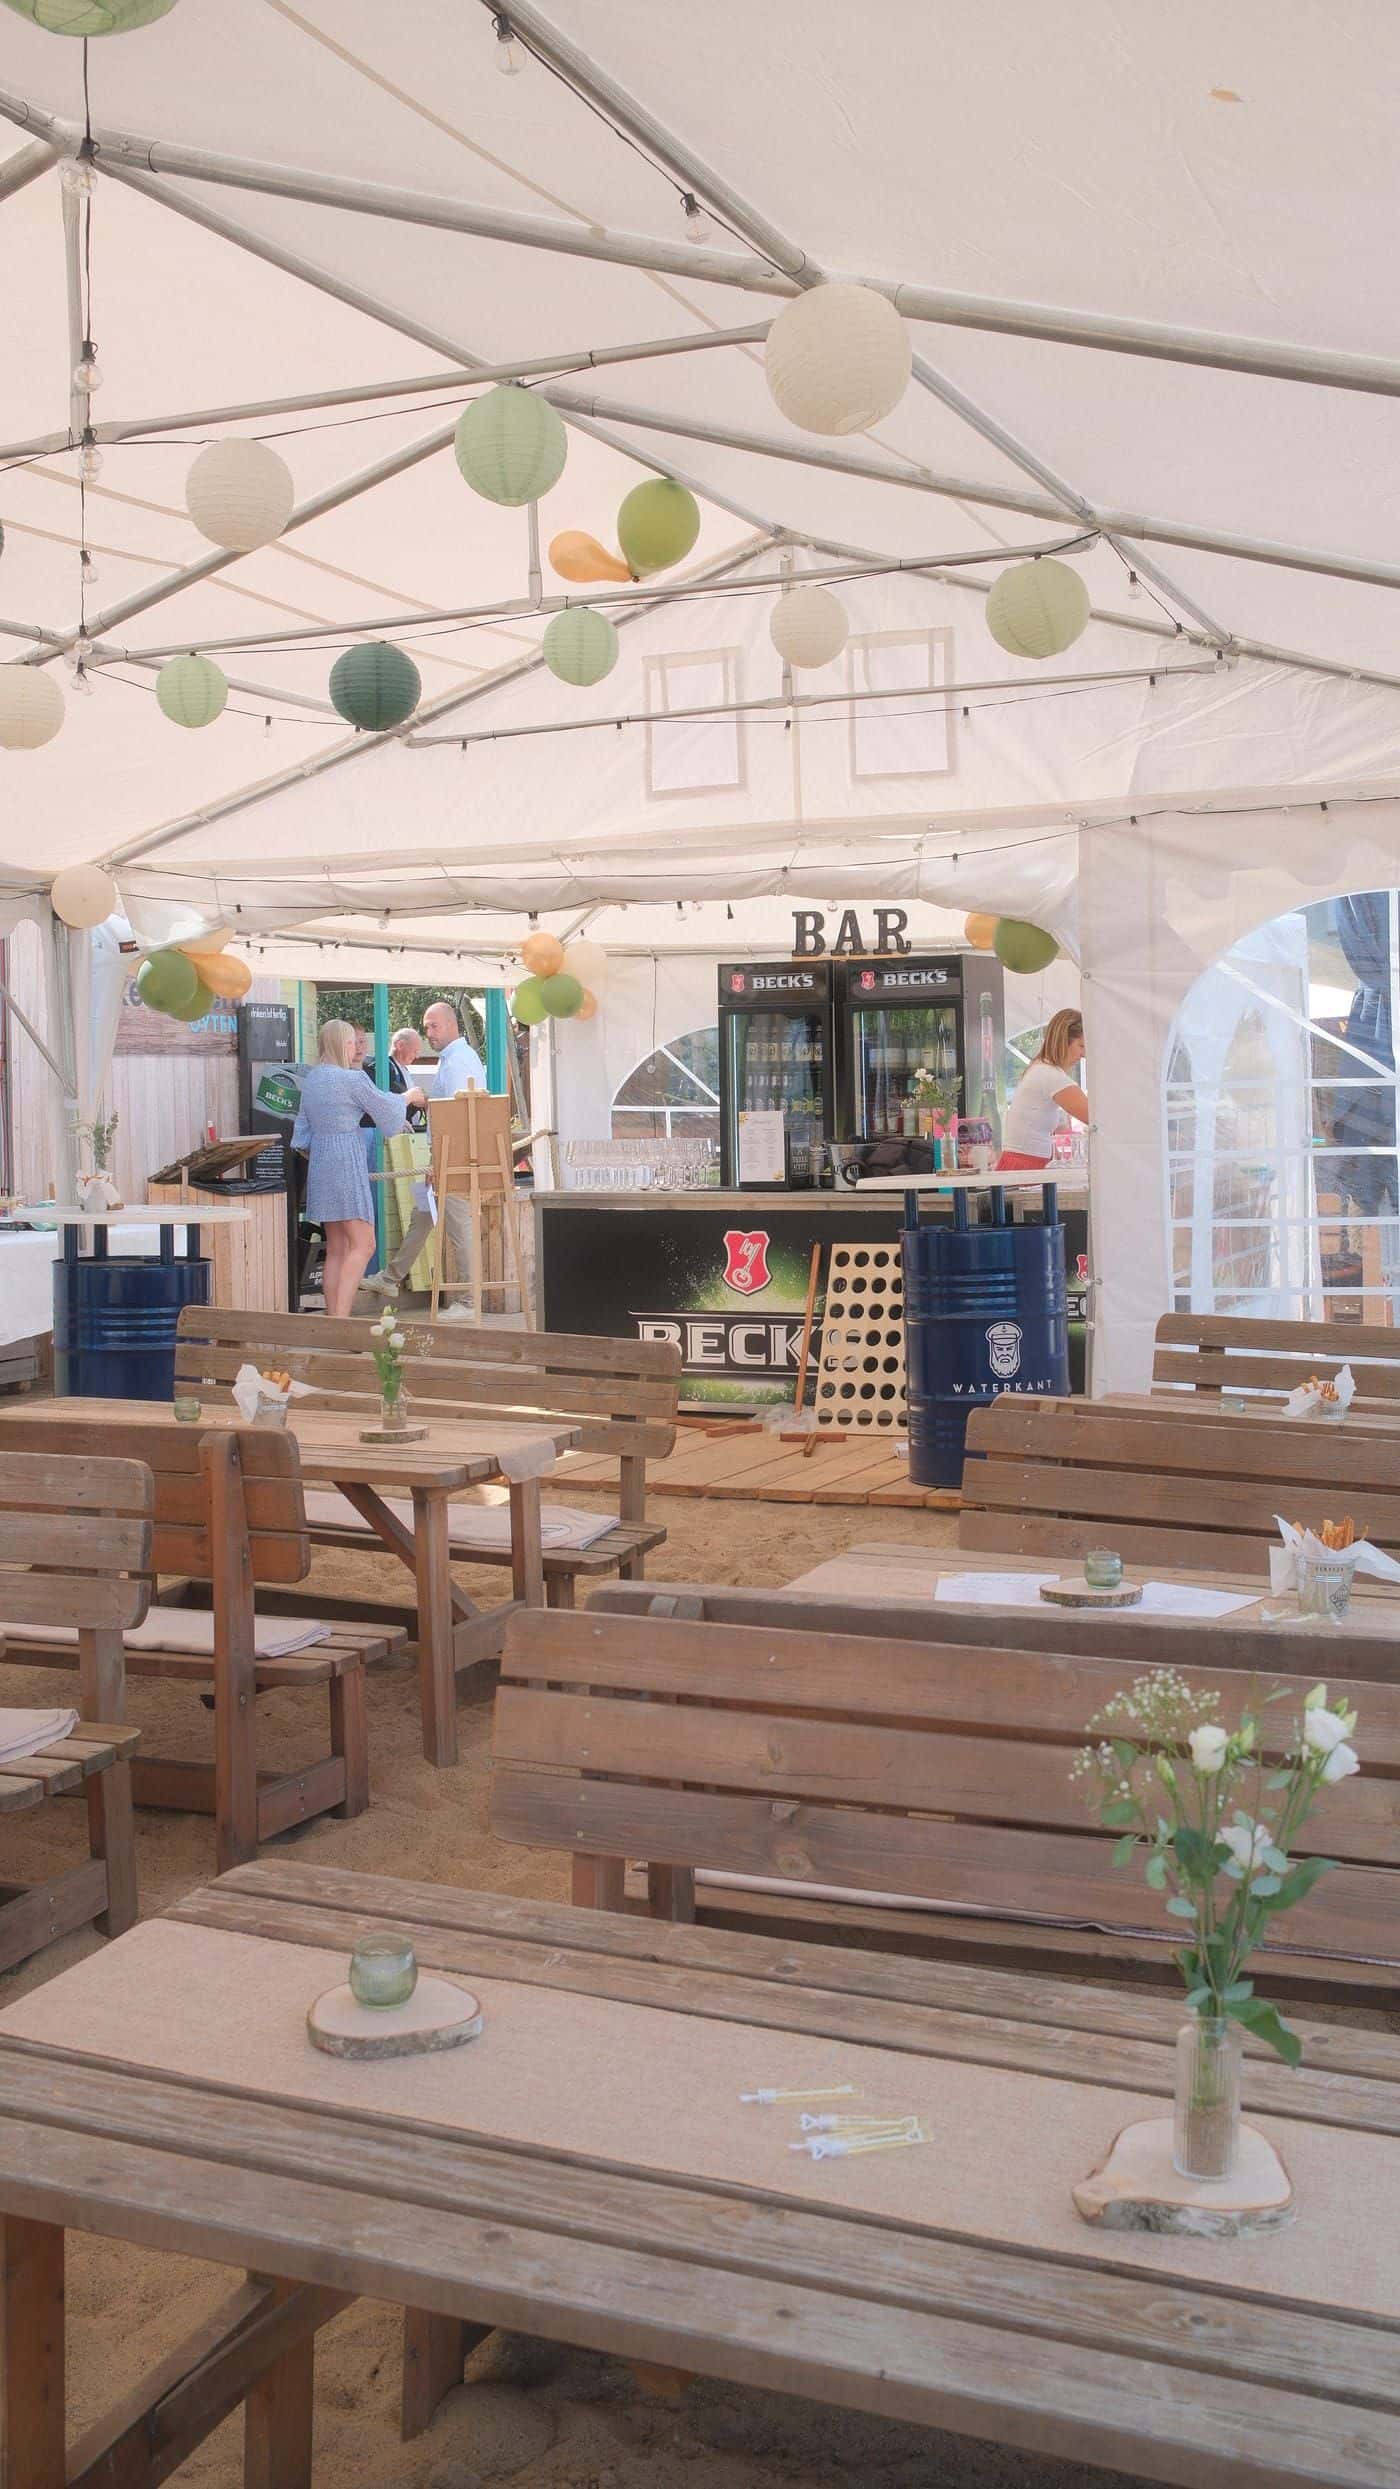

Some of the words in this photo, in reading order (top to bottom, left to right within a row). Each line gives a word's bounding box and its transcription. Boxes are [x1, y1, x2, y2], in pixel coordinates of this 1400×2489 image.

[791, 908, 912, 957] BAR
[752, 973, 814, 989] BECK'S
[883, 969, 948, 986] BECK'S
[638, 1320, 860, 1368] BECK
[952, 1379, 1052, 1394] WATERKANT
